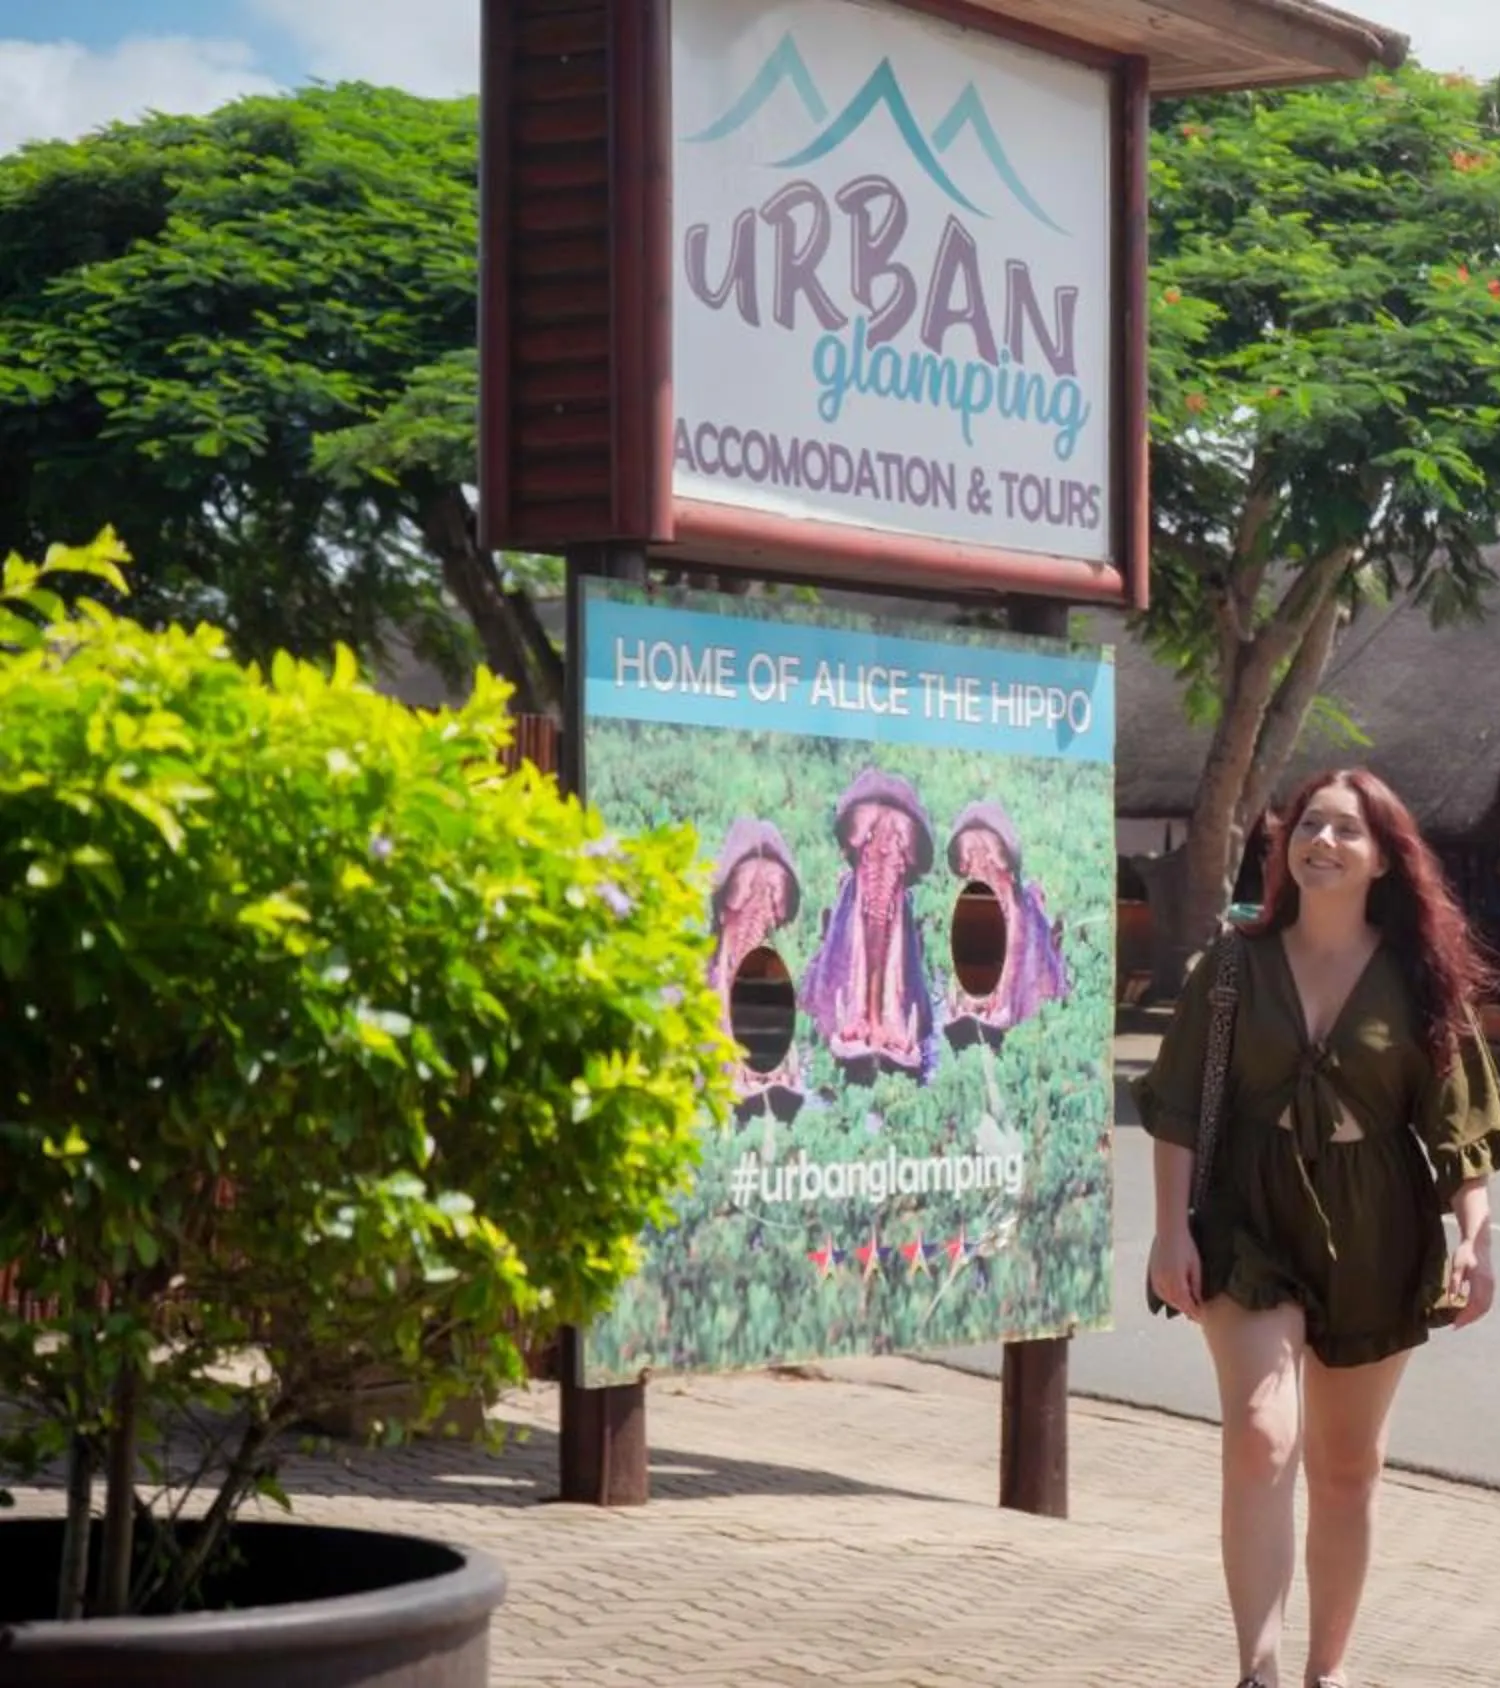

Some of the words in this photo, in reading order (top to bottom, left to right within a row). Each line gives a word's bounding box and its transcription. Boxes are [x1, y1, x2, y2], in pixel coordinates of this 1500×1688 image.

[684, 174, 1078, 377] URBAN
[812, 315, 1090, 462] glamping
[673, 417, 957, 511] ACCOMODATION
[967, 466, 992, 516] &
[1000, 470, 1102, 530] TOURS
[614, 636, 737, 699] HOME
[747, 652, 801, 702] OF
[811, 660, 911, 716] ALICE
[918, 671, 982, 724] THE
[990, 680, 1092, 734] HIPPO
[729, 1144, 1023, 1206] #urbanglamping
